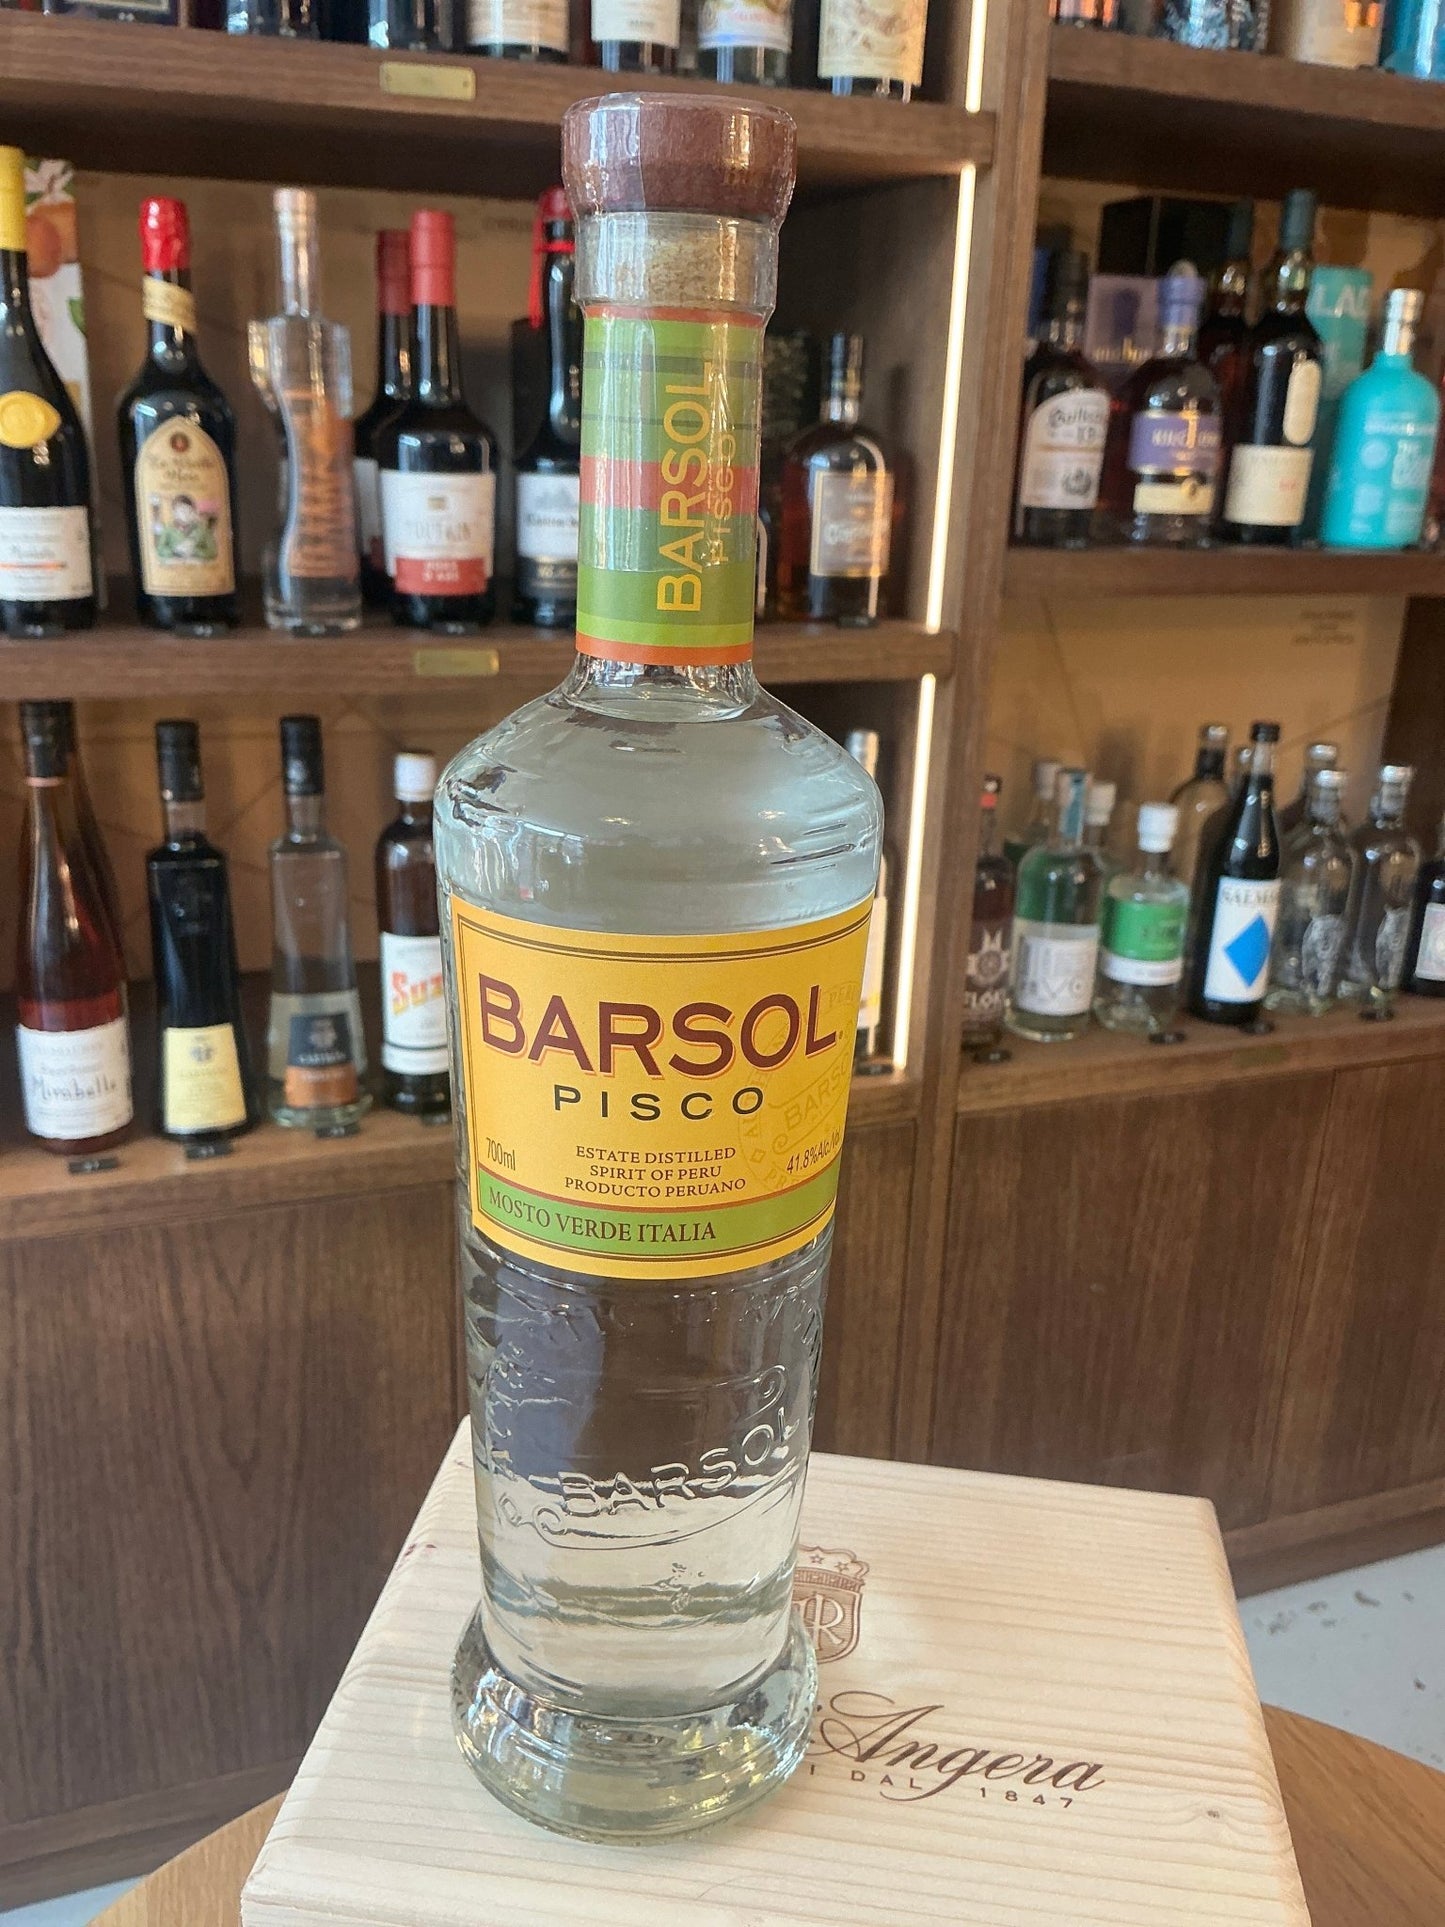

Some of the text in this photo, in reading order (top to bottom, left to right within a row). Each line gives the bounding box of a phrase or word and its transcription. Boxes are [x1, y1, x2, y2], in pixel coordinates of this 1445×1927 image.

[656, 361, 714, 612] BARSOL
[710, 433, 737, 563] PISCO
[478, 972, 837, 1078] BARSOL
[553, 1083, 764, 1121] PISCO
[486, 1136, 516, 1171] 700ml
[576, 1145, 736, 1163] ESTATE DISTILLED
[590, 1164, 722, 1181] SPIRIT OF PERU
[565, 1176, 746, 1198] PRODUCTO PERUANO
[488, 1186, 717, 1242] MOSTO VERDE ITALIA
[851, 1769, 1074, 1809] DAL 1847
